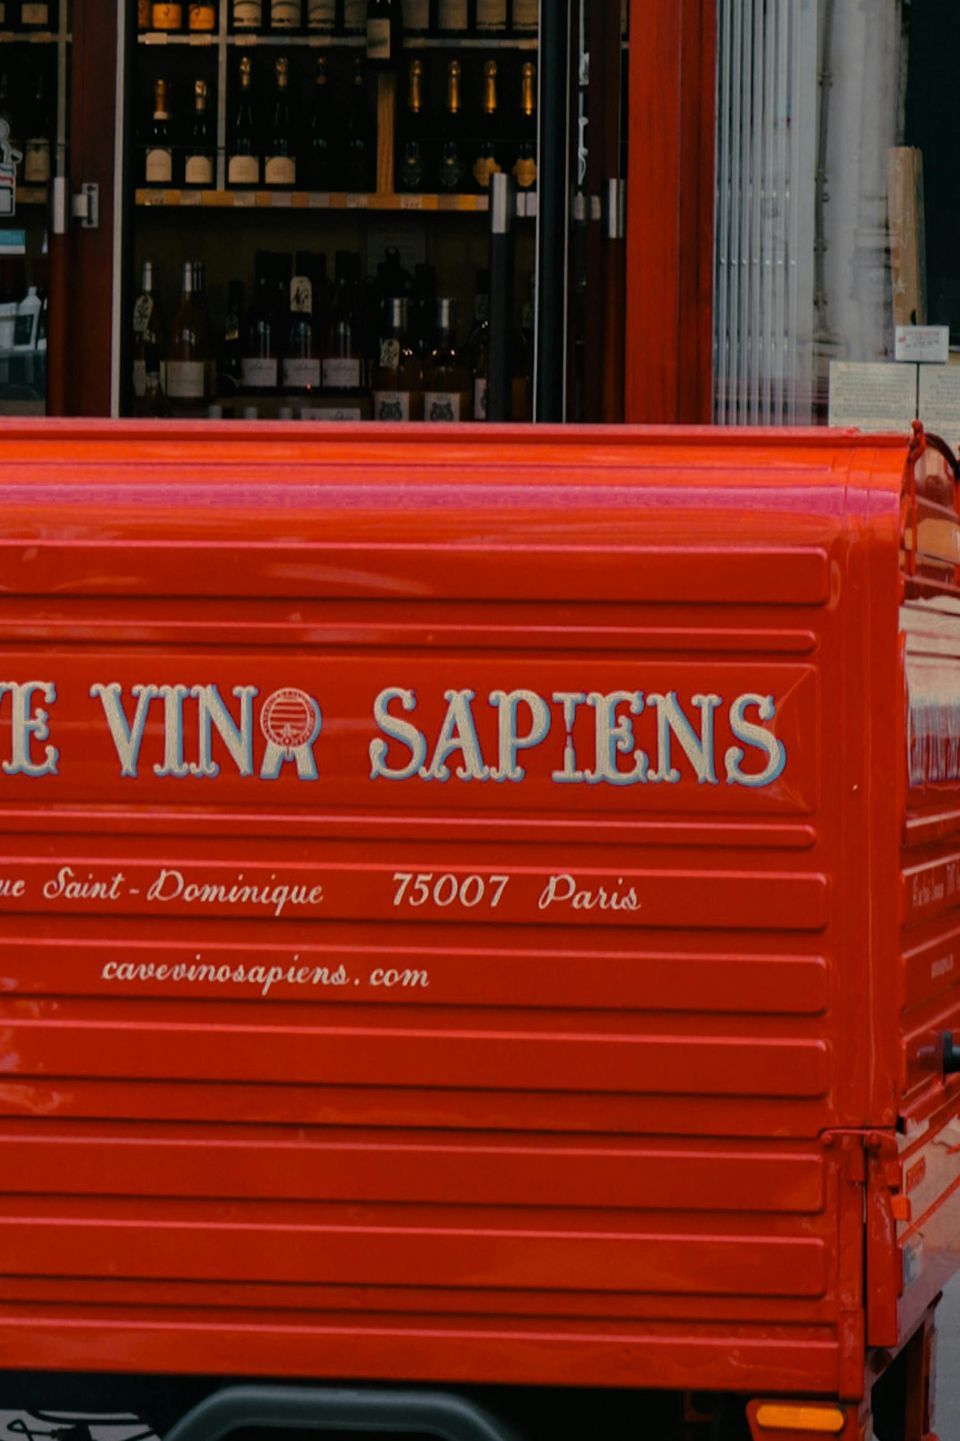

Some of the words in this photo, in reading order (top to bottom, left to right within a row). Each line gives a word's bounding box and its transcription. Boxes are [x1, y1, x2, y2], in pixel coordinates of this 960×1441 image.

[369, 687, 787, 787] SAPIENS
[391, 872, 510, 907] 75007
[538, 872, 642, 911] Paris
